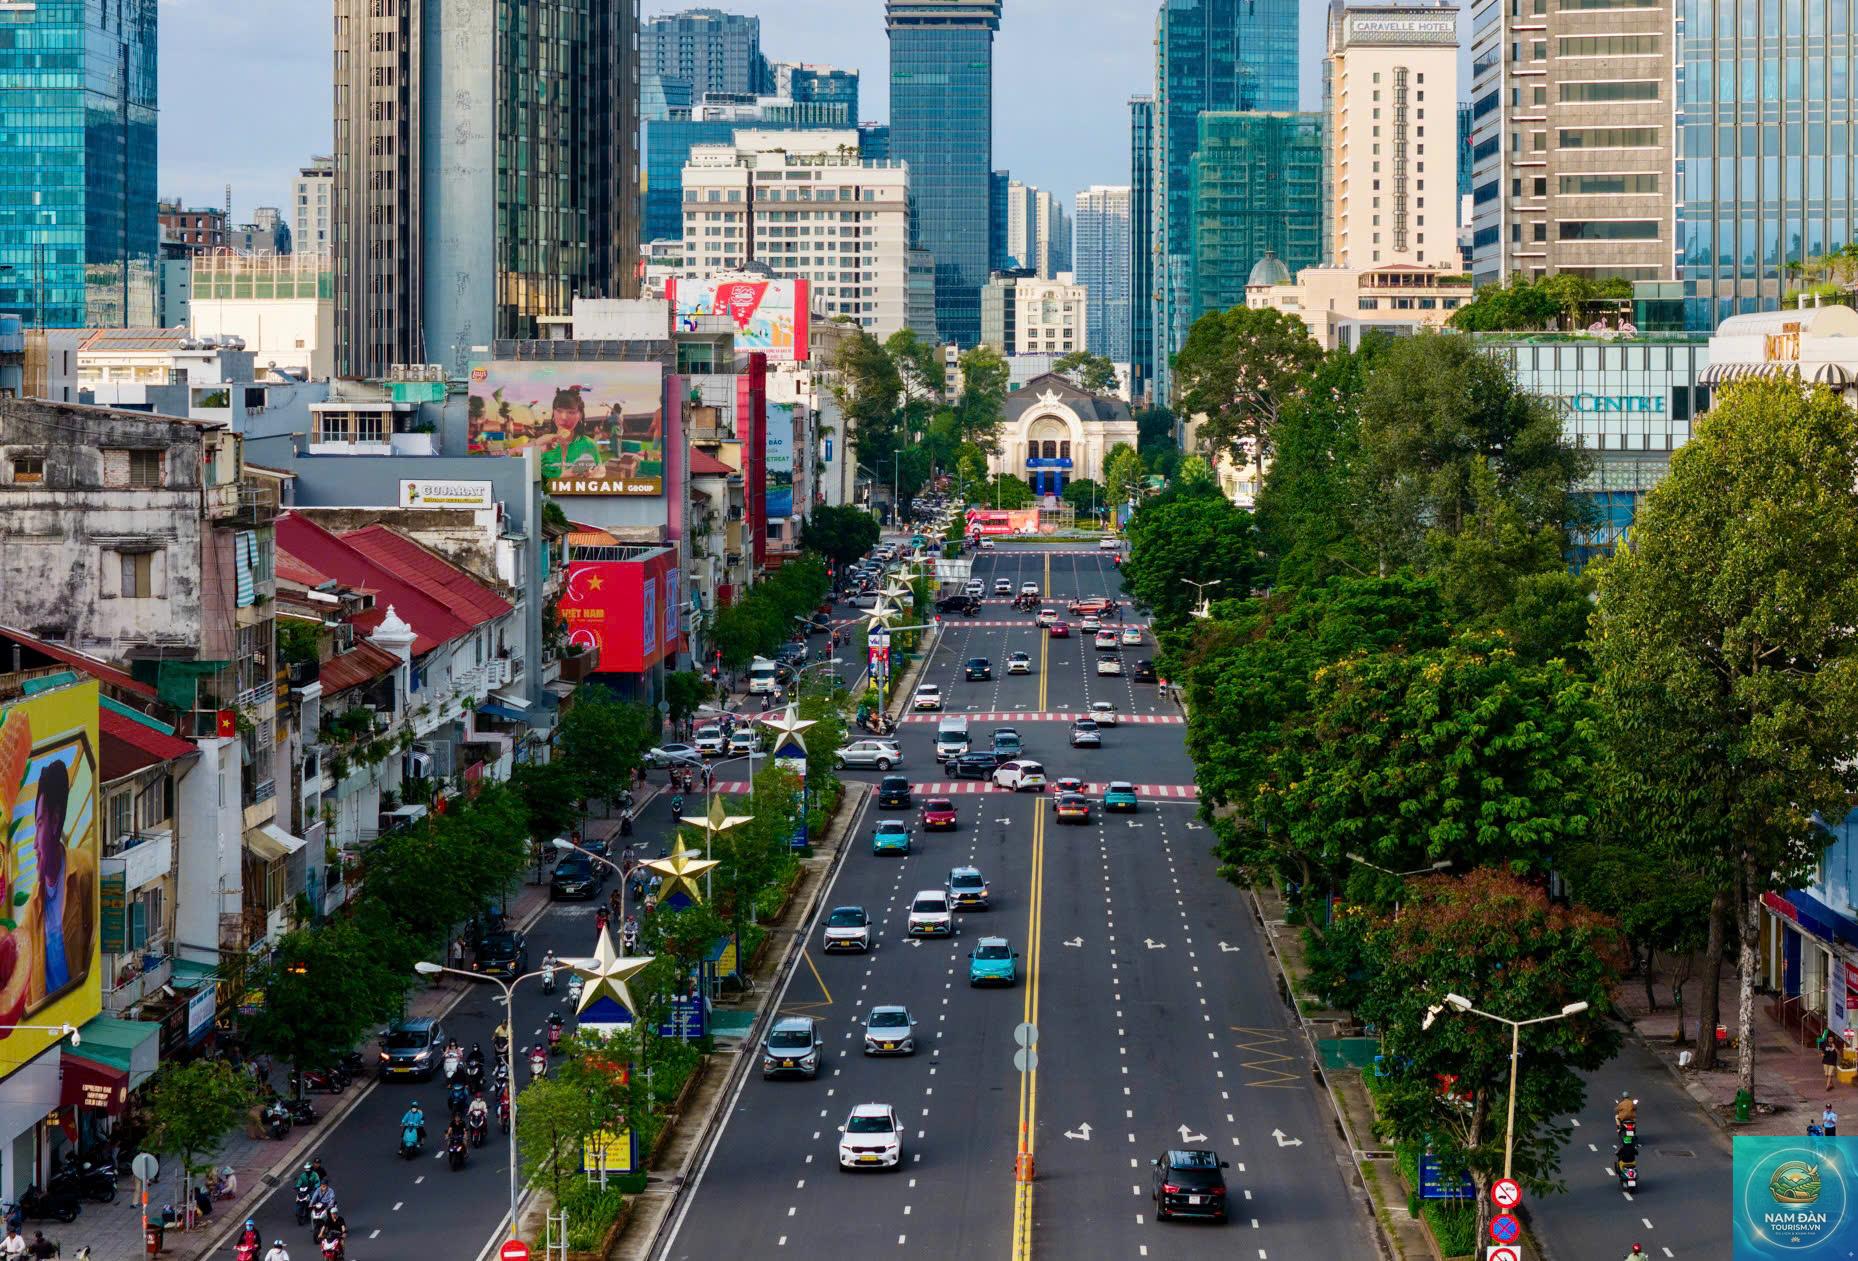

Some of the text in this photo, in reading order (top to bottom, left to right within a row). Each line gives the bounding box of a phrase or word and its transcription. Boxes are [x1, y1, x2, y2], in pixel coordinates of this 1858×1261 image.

[1357, 22, 1451, 31] CARAVELLE HOTEL
[423, 486, 484, 496] GUJARAT
[575, 481, 624, 492] NGAN
[627, 484, 655, 492] GROUP
[583, 608, 605, 618] NAM
